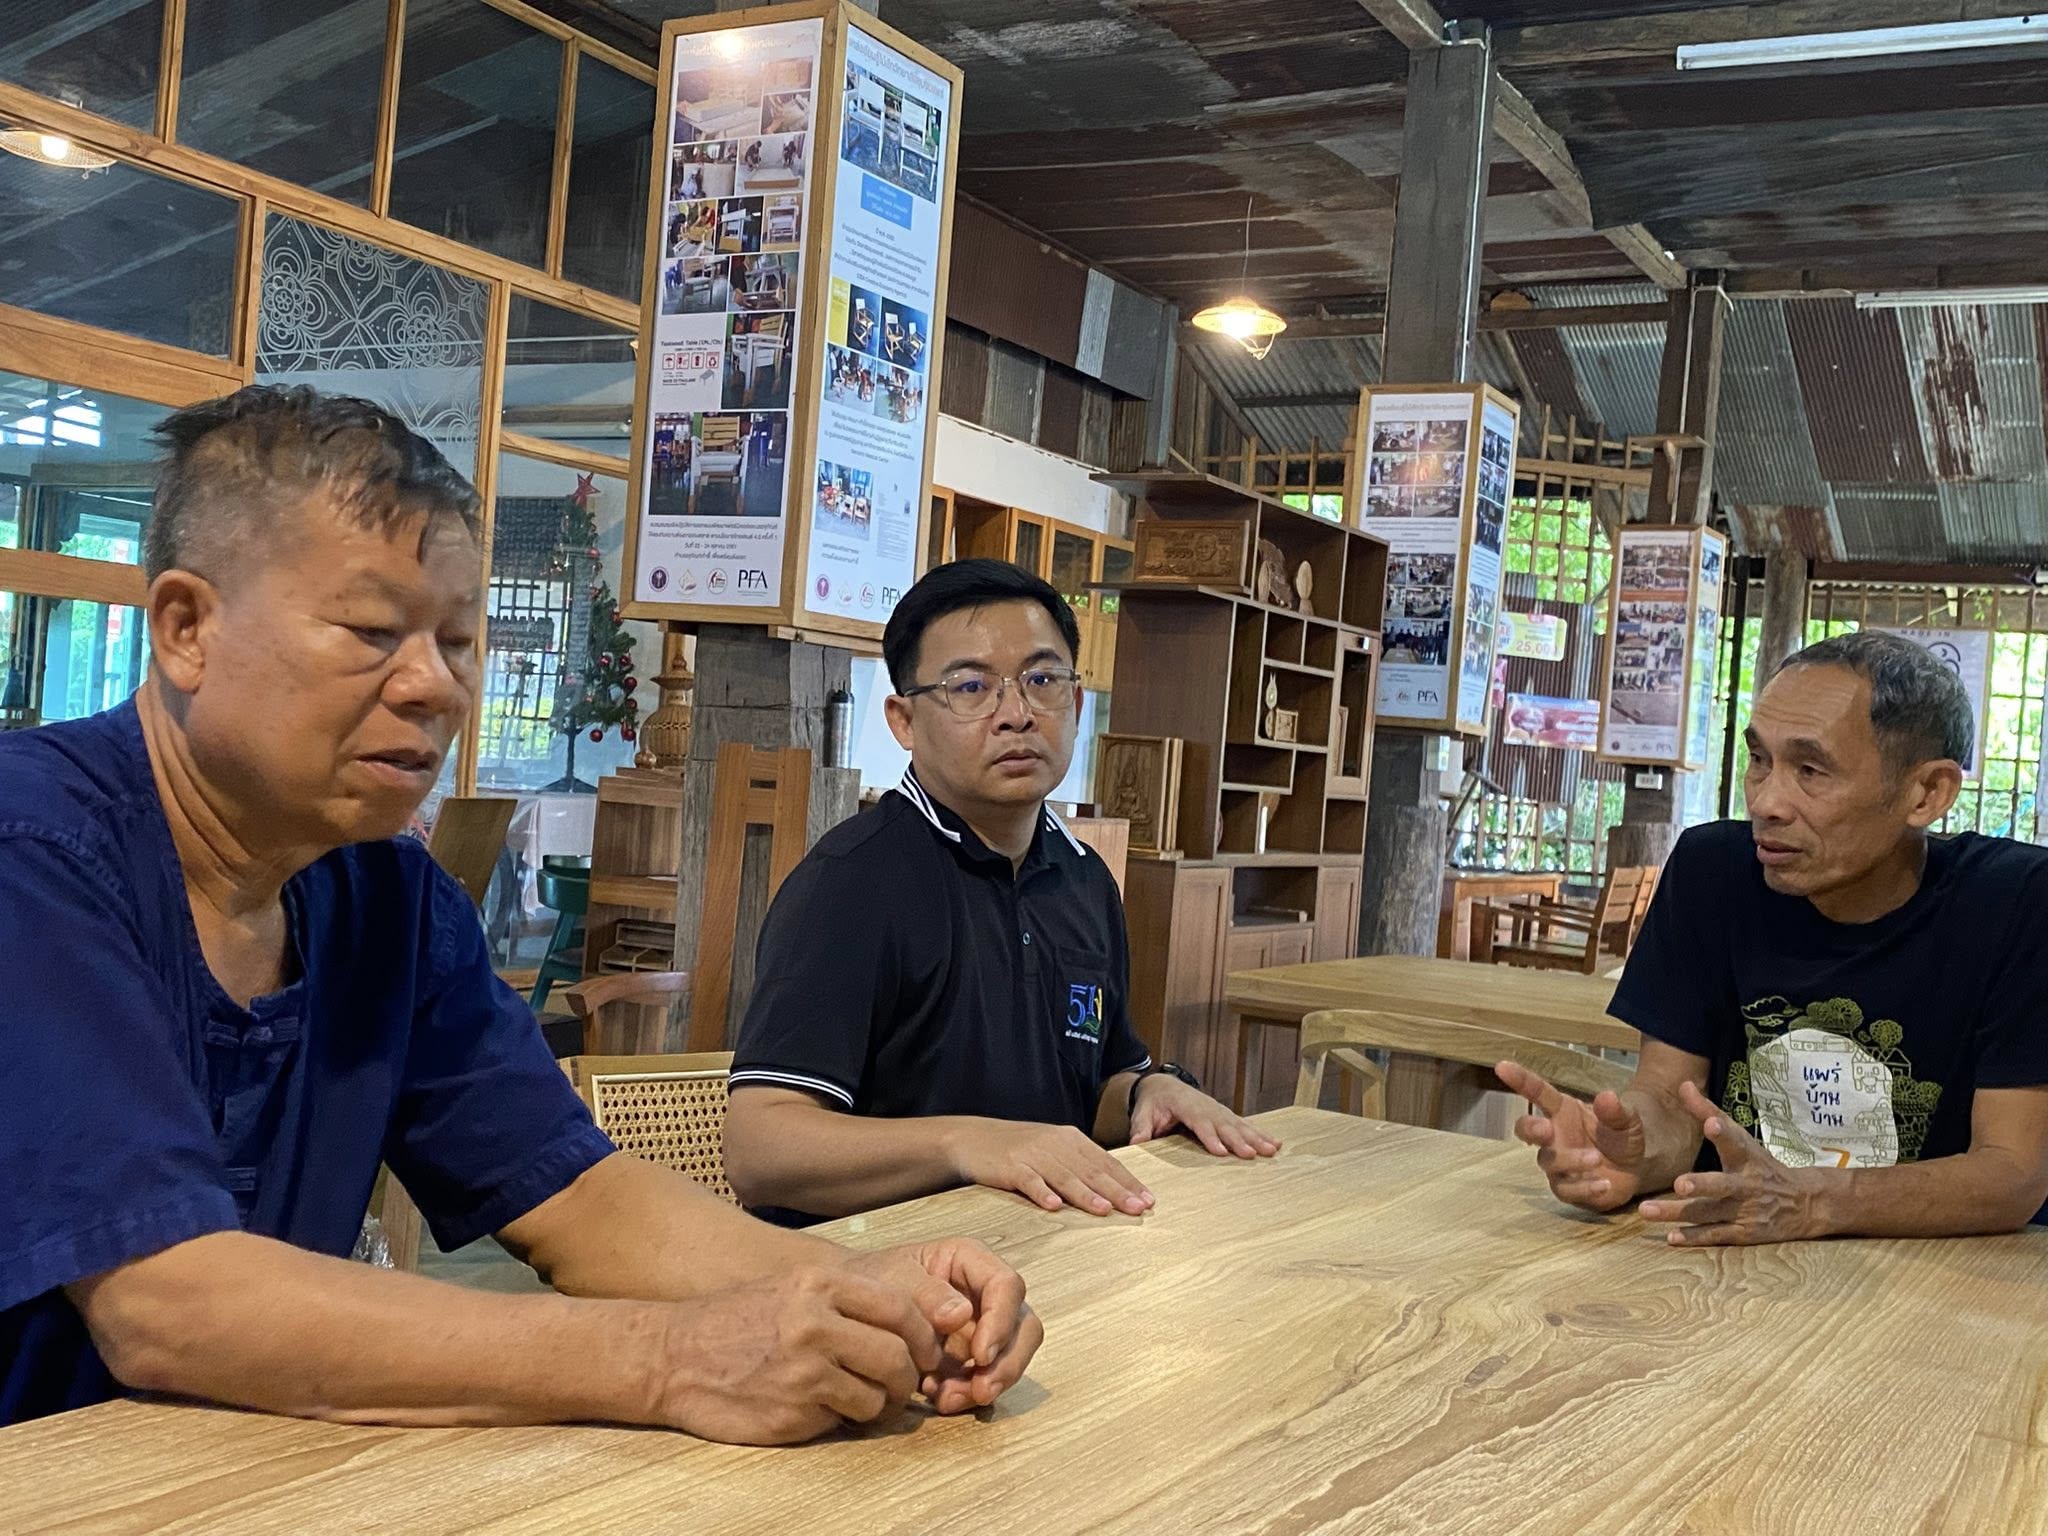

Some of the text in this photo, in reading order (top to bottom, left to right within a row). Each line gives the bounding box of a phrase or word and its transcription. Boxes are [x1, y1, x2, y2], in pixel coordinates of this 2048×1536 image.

[738, 569, 768, 589] PFA
[1417, 689, 1439, 703] PFA
[1803, 1062, 1842, 1084] แพร่
[1806, 1084, 1841, 1106] บ้าน
[1811, 1105, 1844, 1127] บ้าน
